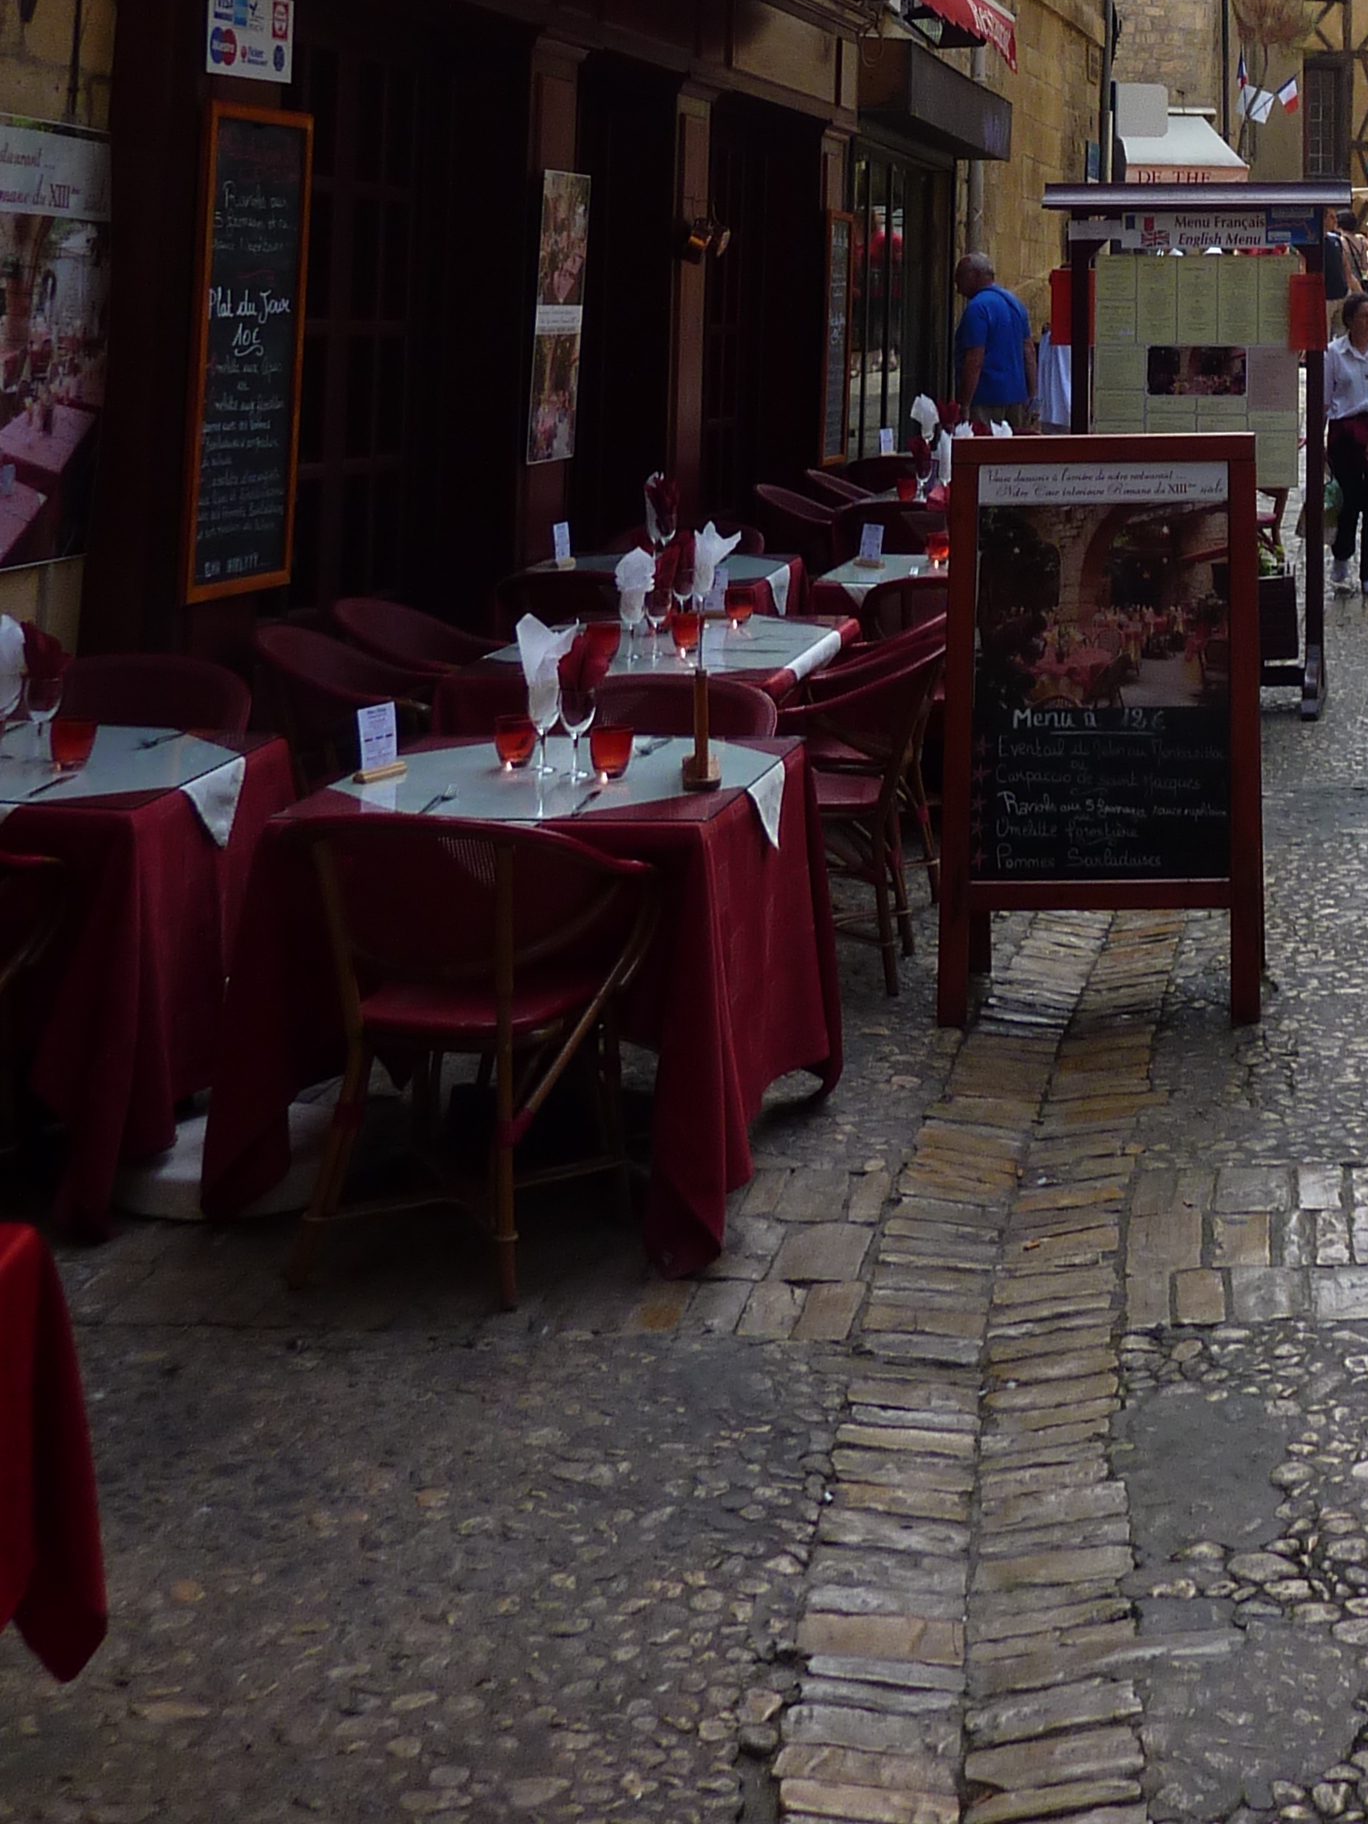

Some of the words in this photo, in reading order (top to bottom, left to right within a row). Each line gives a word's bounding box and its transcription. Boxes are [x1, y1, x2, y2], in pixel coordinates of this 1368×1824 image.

[1175, 215, 1210, 227] Menu
[1214, 215, 1265, 230] Français
[1179, 233, 1220, 247] English
[1226, 233, 1261, 245] Menu
[208, 286, 234, 320] Plat
[236, 288, 257, 316] du
[1012, 707, 1076, 730] Menu
[995, 762, 1072, 791] Carpaccio
[996, 842, 1056, 870] Pommes
